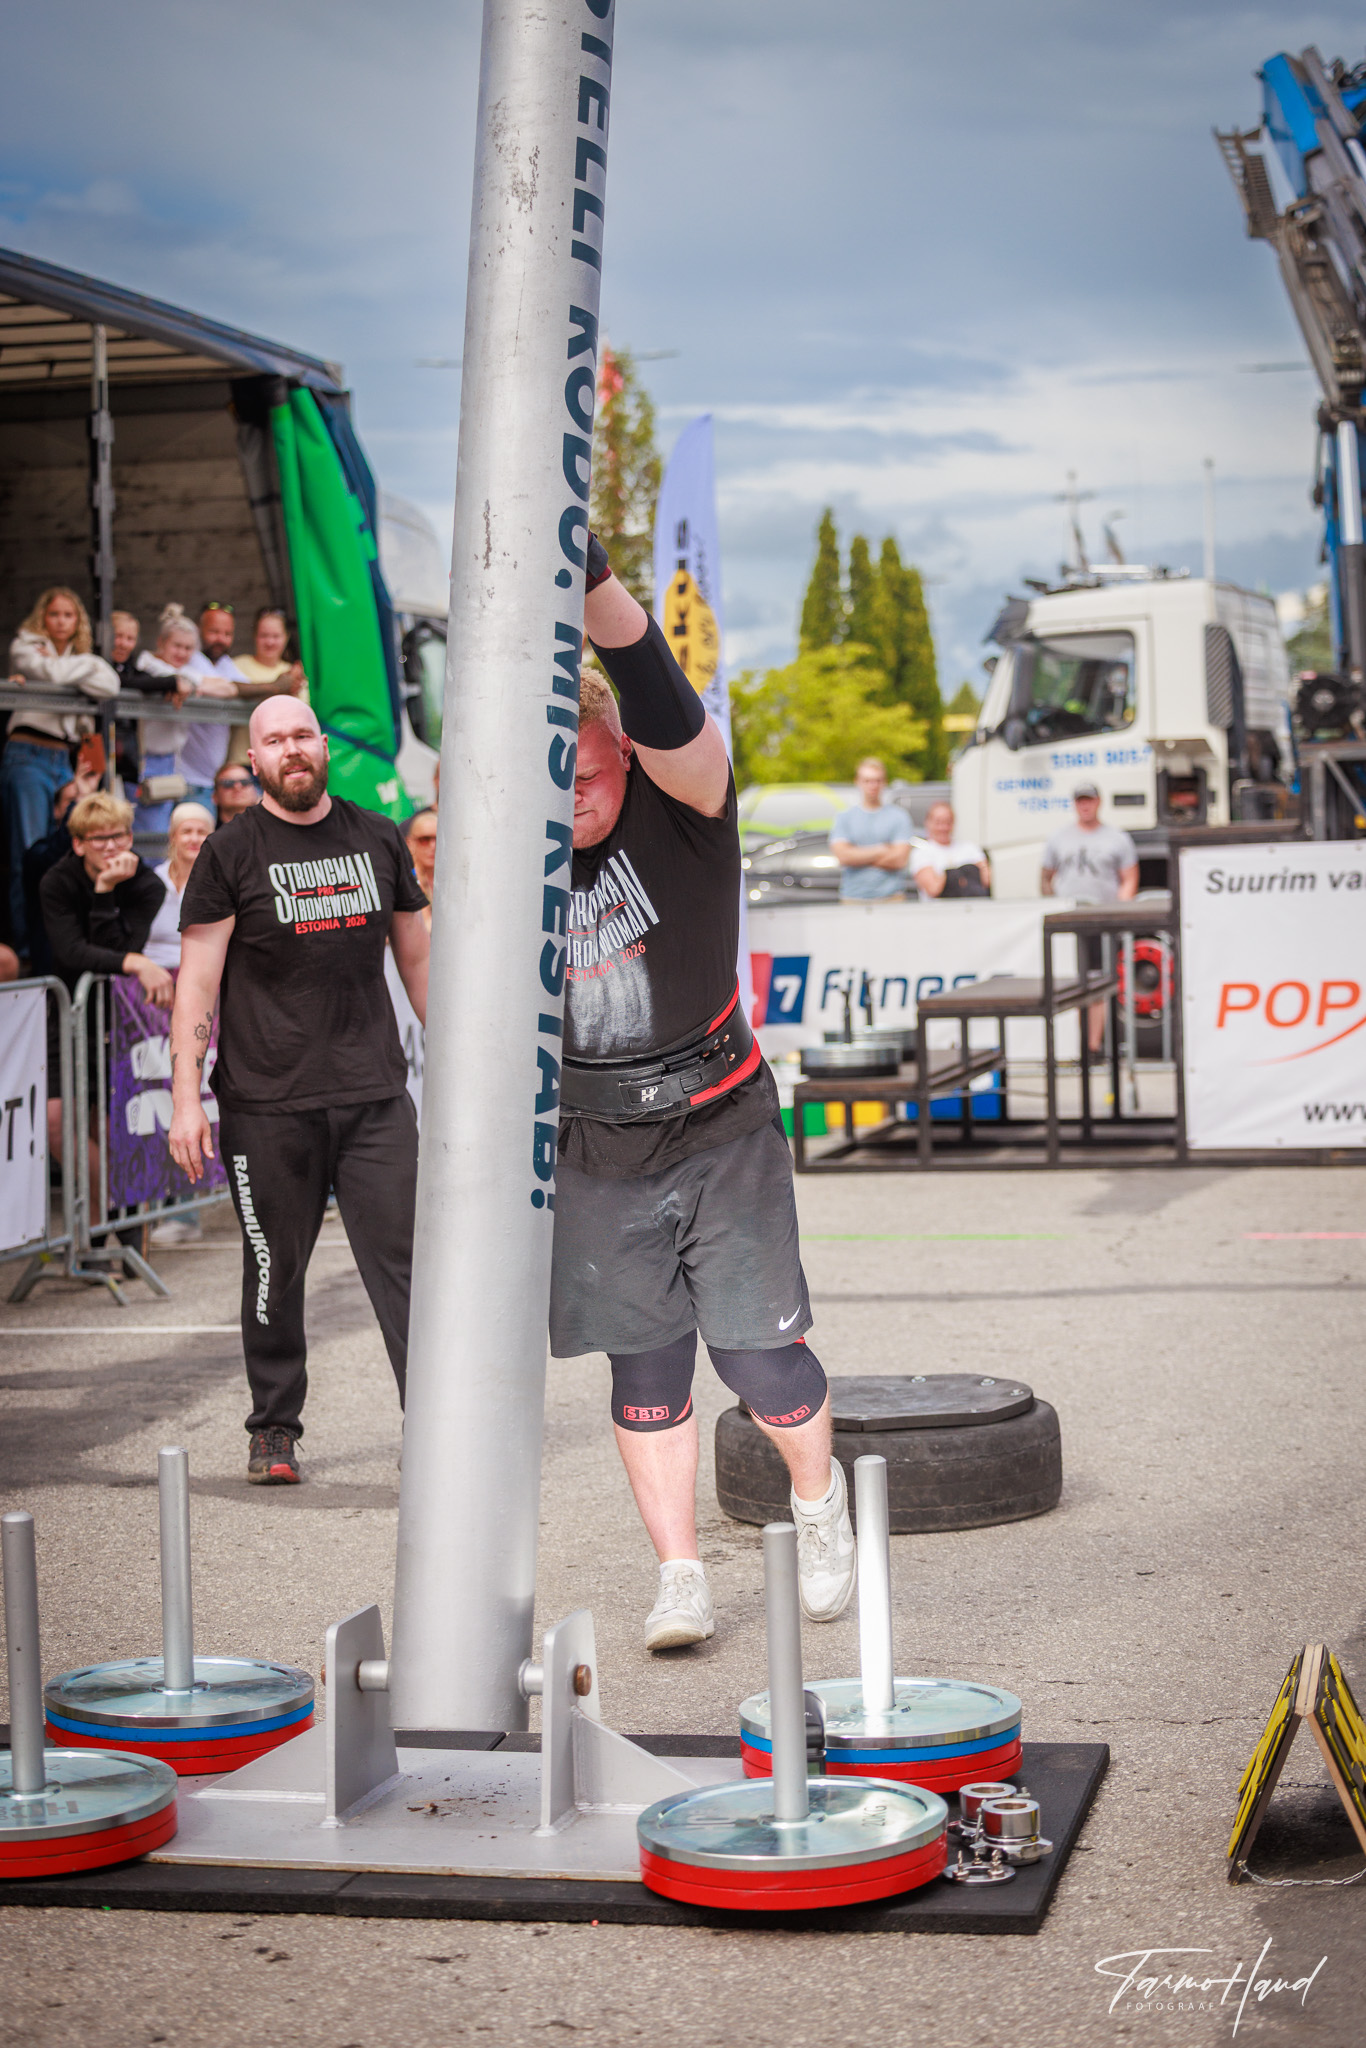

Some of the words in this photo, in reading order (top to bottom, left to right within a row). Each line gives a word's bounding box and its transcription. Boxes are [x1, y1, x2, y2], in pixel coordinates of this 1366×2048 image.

[547, 621, 584, 791] MIS
[317, 885, 336, 897] PRO
[1206, 868, 1318, 895] Suurim
[1329, 869, 1366, 892] va
[295, 918, 341, 935] ESTONIA
[345, 914, 367, 928] 2026
[566, 959, 615, 982] ESTONIA
[619, 940, 647, 965] 2026
[232, 1154, 271, 1326] RAMMUKOOBAS
[626, 1408, 666, 1420] SBD
[766, 1407, 808, 1424] SBD
